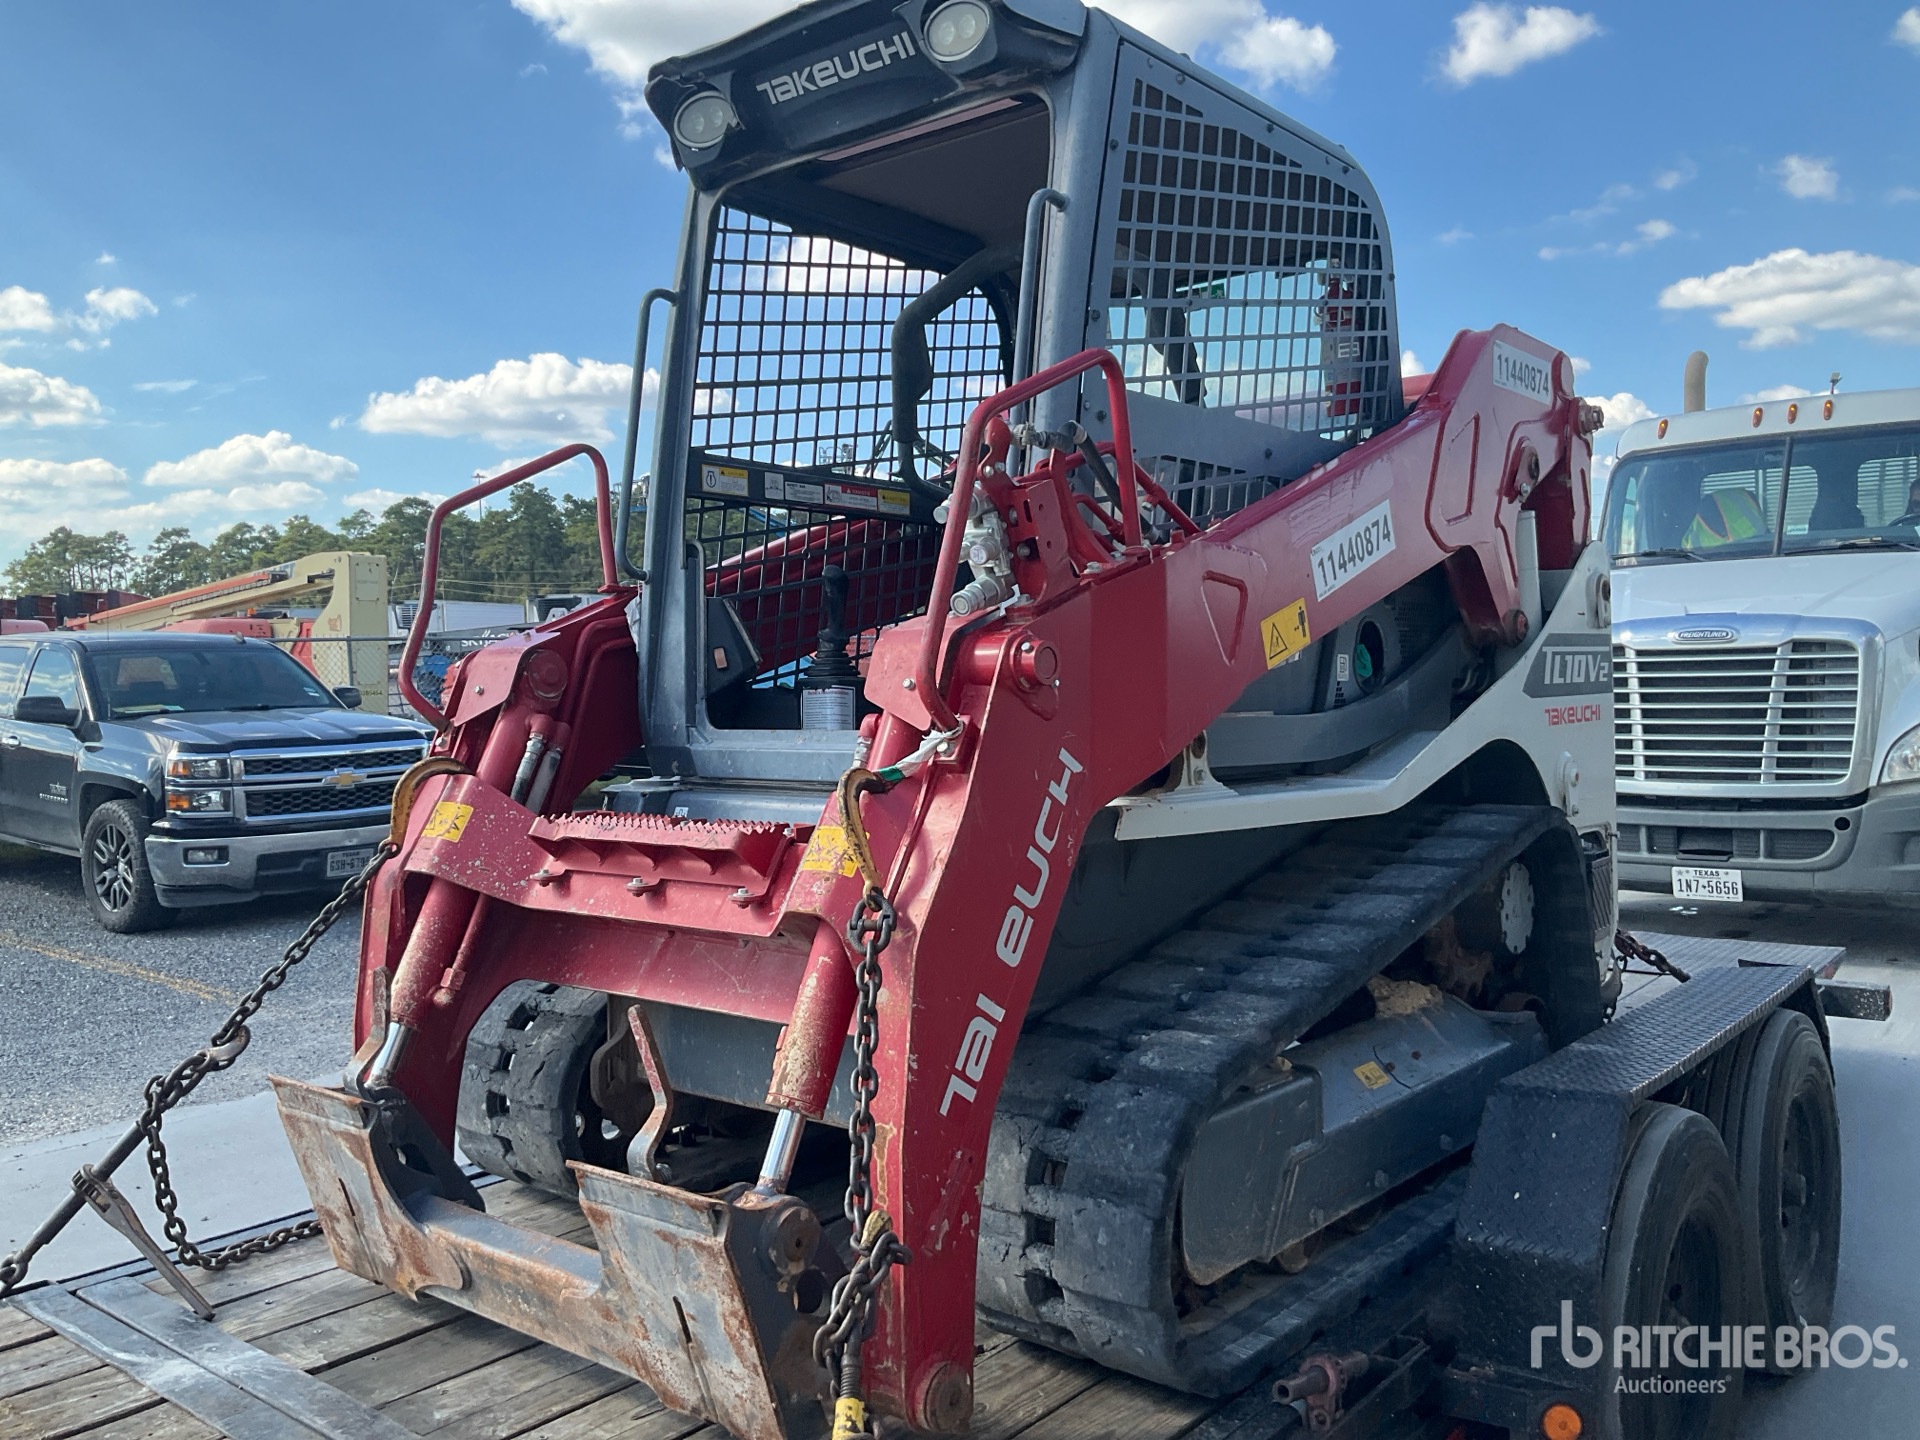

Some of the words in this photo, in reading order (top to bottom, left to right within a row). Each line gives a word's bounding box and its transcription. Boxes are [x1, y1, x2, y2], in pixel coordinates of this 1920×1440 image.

[1497, 353, 1550, 396] 11440874
[1317, 514, 1391, 587] 11440874
[1680, 630, 1728, 638] FREIGHTLINER
[1542, 646, 1610, 685] TL10V2
[1693, 869, 1720, 877] TEXAS
